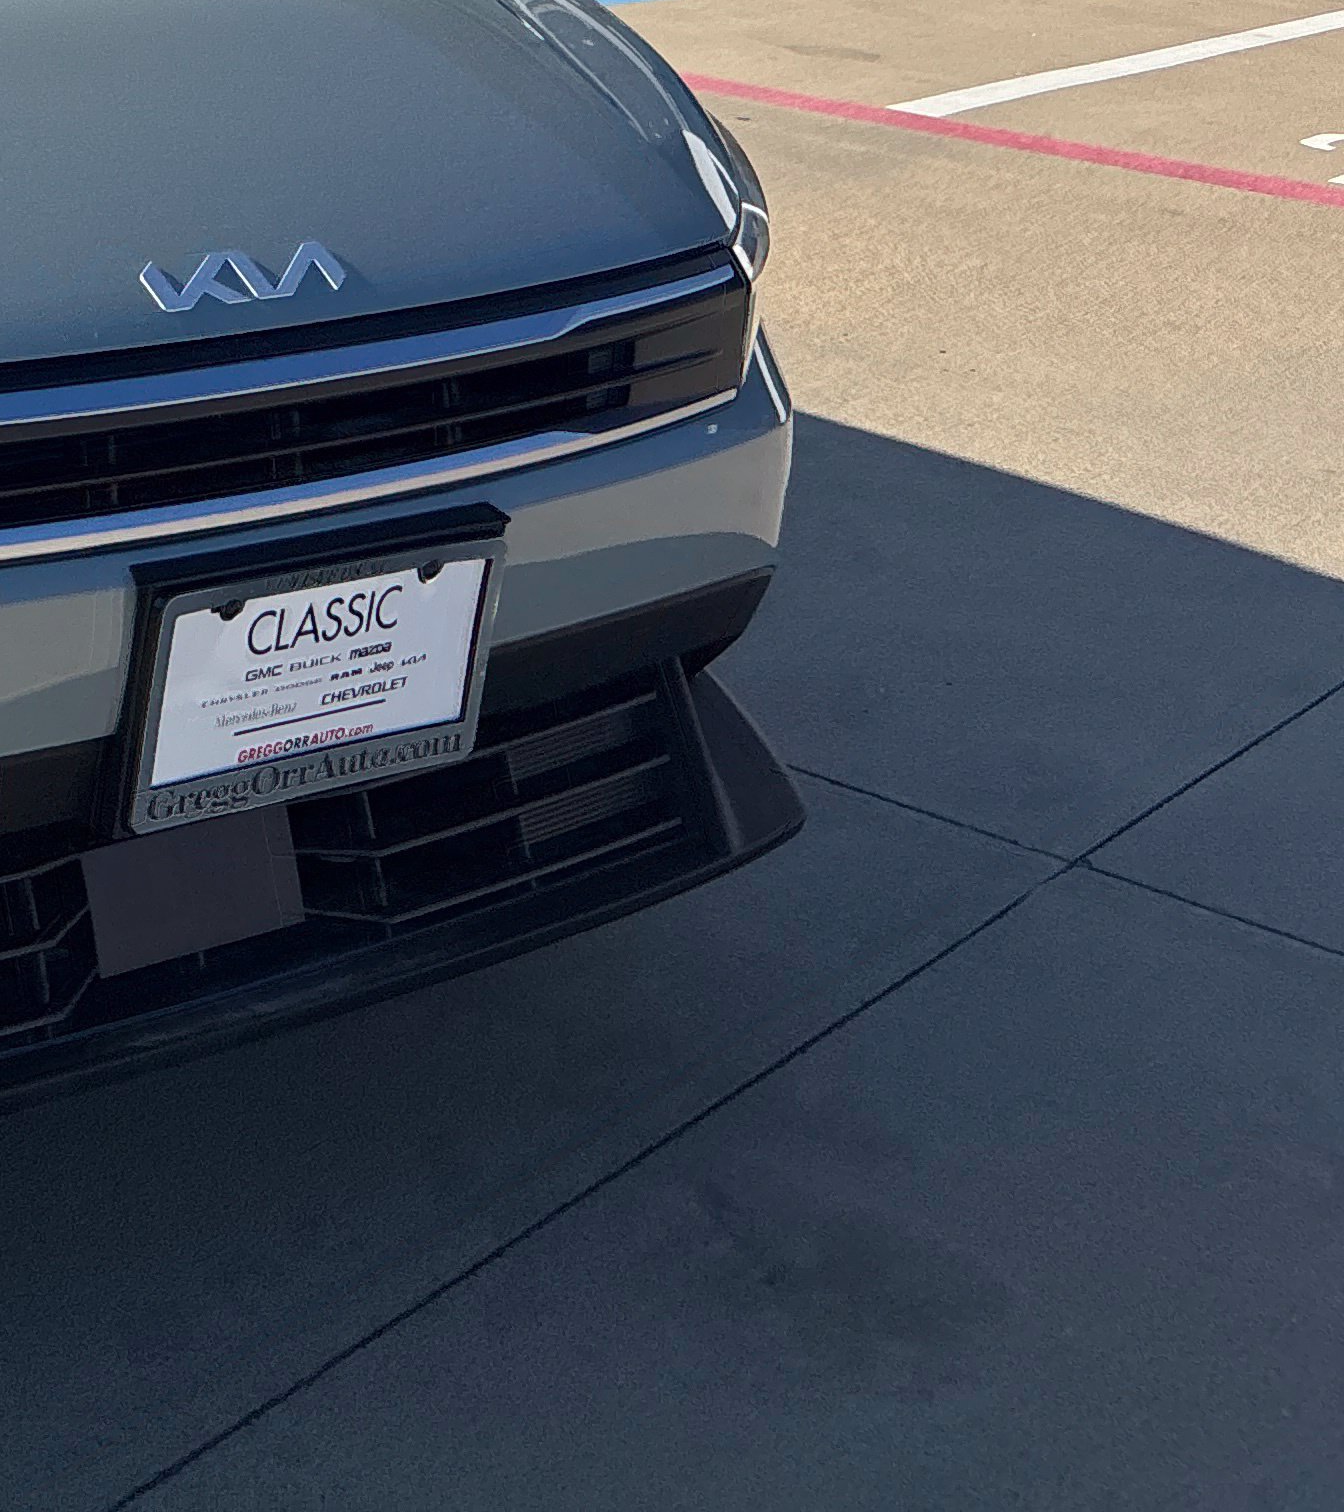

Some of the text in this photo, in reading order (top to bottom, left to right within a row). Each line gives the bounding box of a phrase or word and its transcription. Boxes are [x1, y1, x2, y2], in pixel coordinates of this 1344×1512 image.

[138, 241, 346, 313] KIA
[247, 584, 403, 656] CLASSIC
[245, 663, 284, 683] GMC
[289, 652, 342, 673] BUICK
[329, 667, 363, 682] RAM
[369, 660, 395, 674] Jeep
[321, 675, 409, 707] CHEVROLET
[237, 723, 374, 764] GREGGORRAUTO.com
[146, 733, 463, 822] GreggOrrAuto.com
